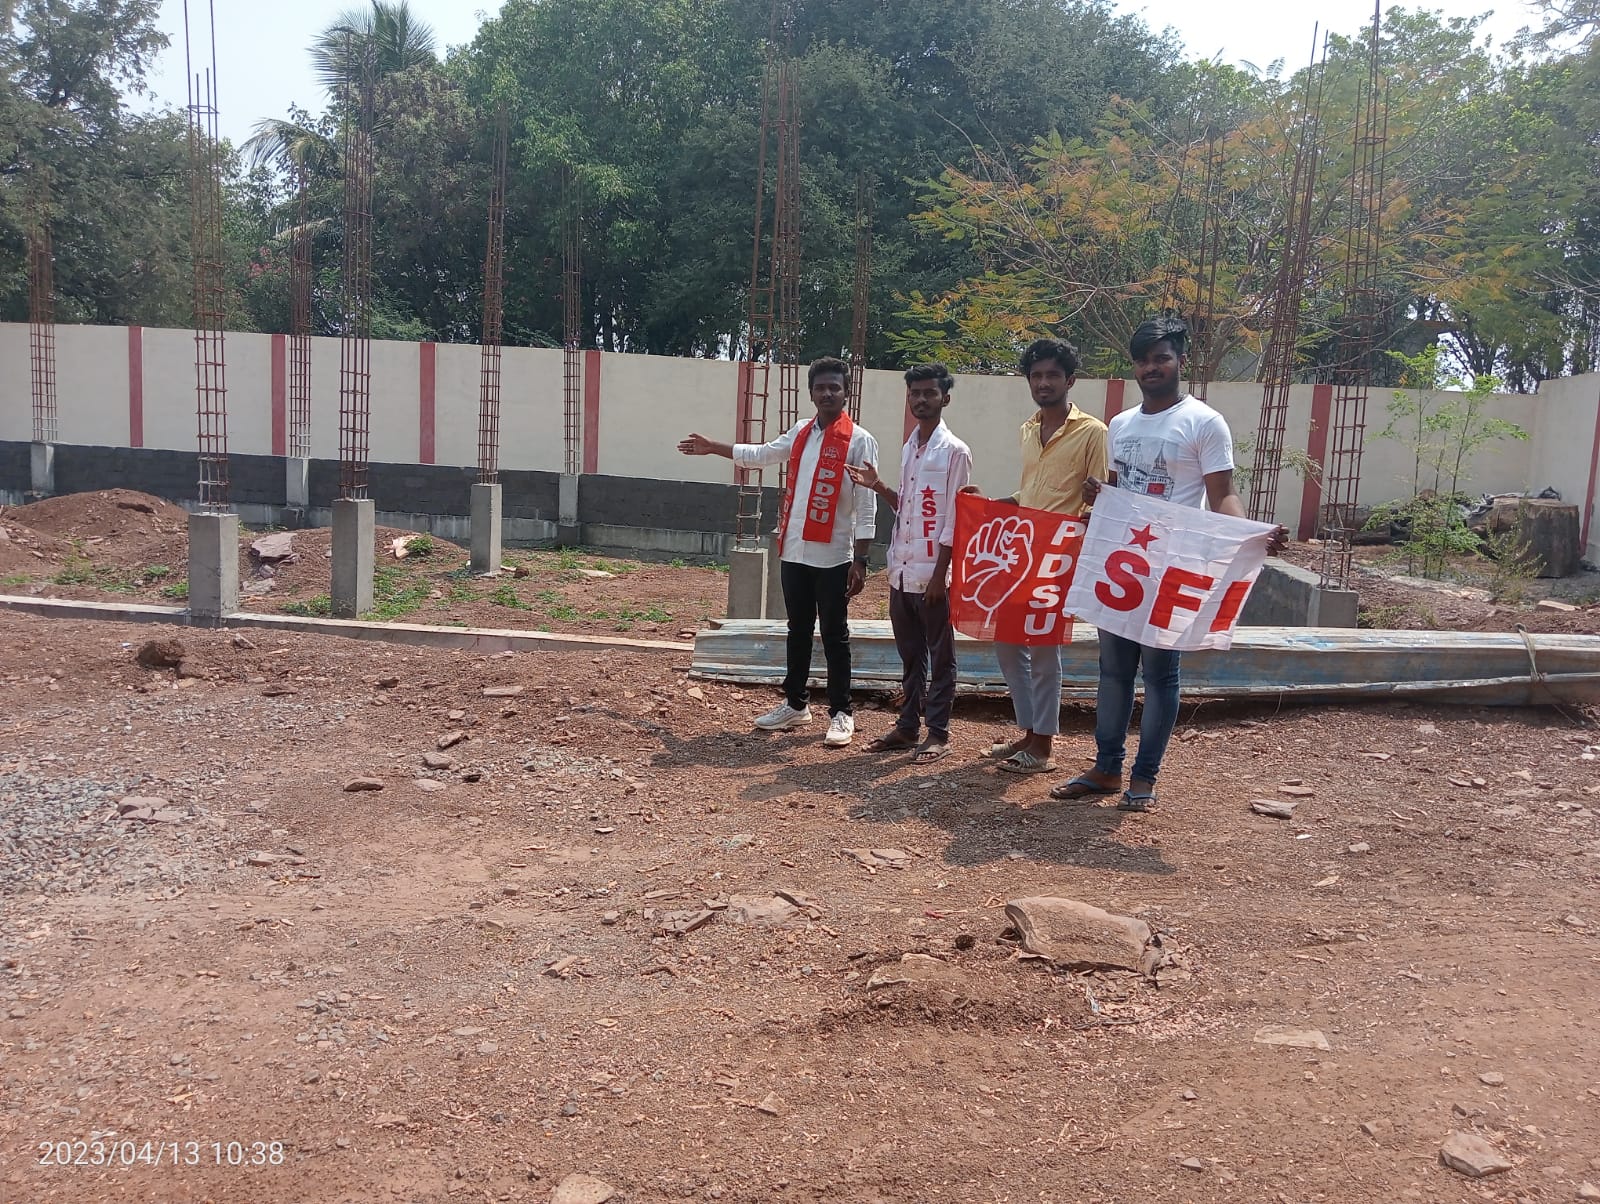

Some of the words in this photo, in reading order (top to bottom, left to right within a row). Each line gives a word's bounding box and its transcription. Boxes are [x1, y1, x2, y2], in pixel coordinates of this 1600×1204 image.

[809, 468, 836, 524] PDSU
[921, 500, 937, 557] SFI
[1024, 520, 1086, 635] PDSU
[1094, 550, 1253, 633] SFI
